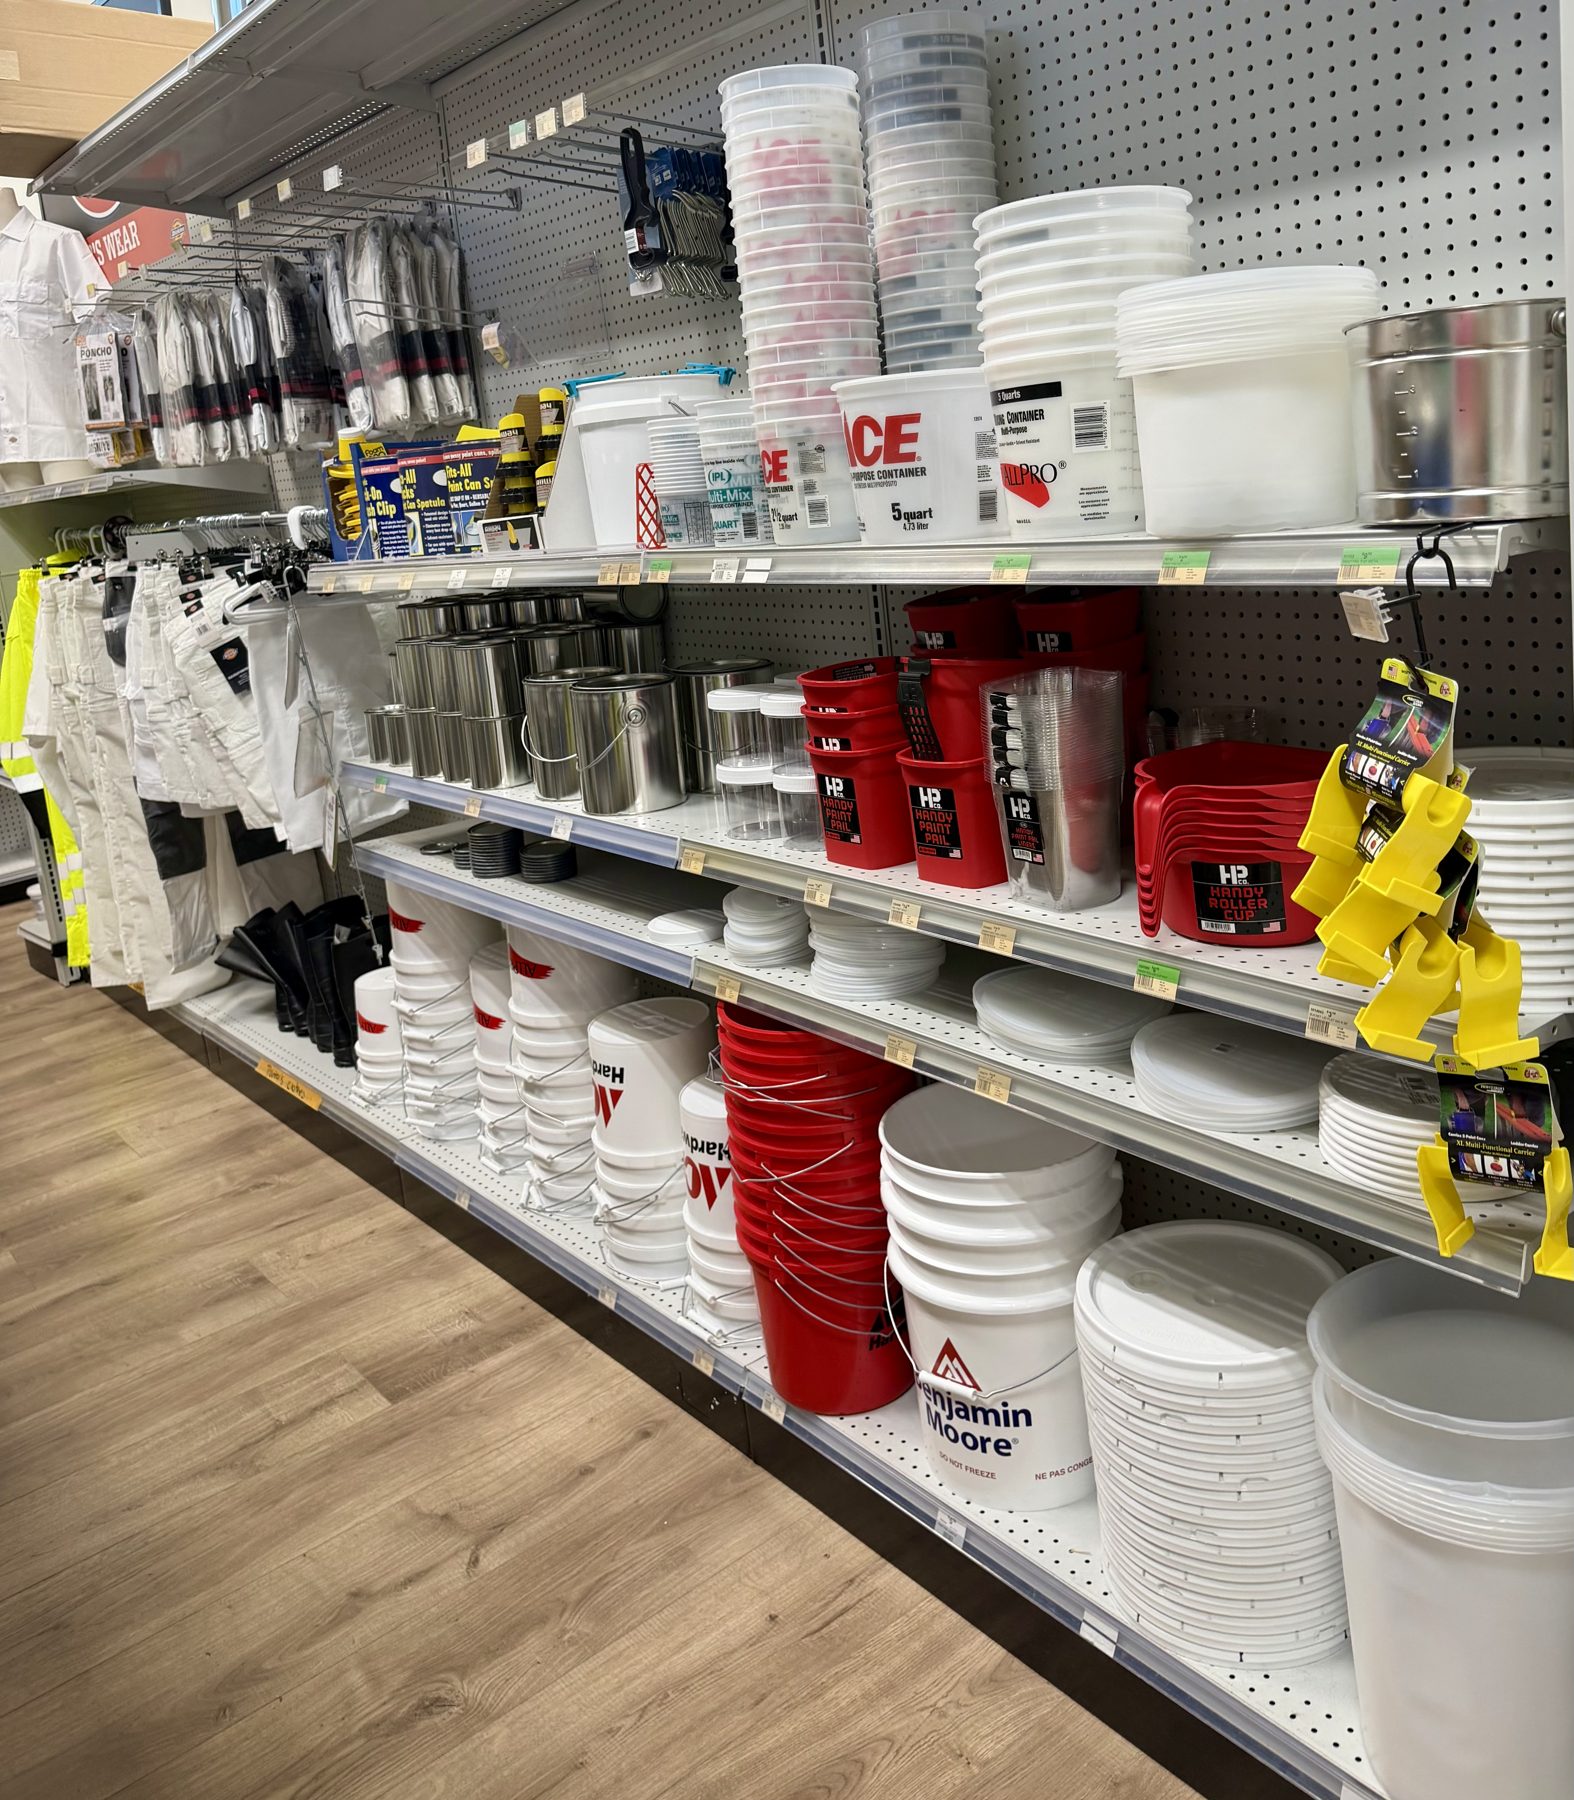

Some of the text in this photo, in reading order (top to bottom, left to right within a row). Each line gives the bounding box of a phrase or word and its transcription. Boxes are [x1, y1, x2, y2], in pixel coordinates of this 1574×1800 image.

[90, 220, 140, 266] 'S WEAR
[80, 346, 112, 358] PONCHO
[1001, 390, 1021, 401] Quarts
[1006, 408, 1045, 425] CONTAINER
[876, 467, 927, 480] CONTAINER
[464, 478, 482, 491] Can
[708, 488, 751, 502] ulti-Mix
[376, 500, 397, 519] Clip
[416, 497, 446, 510] Spatula
[782, 512, 798, 523] quart
[891, 502, 933, 522] 5 quart
[822, 798, 854, 811] HANDY
[825, 809, 852, 822] PAINT
[915, 810, 953, 823] HANDY
[830, 819, 851, 832] PAIL
[918, 821, 951, 835] PAINT
[925, 832, 950, 846] PAIL
[1210, 886, 1264, 898] HANDY
[1208, 897, 1268, 910] ROLLER
[1223, 910, 1255, 921] CUP
[1464, 1141, 1513, 1154] Multi-Functional
[1513, 1148, 1536, 1157] Carrier
[926, 1402, 1012, 1457] Moore
[949, 1457, 963, 1470] NOT
[964, 1464, 997, 1480] FREEZE
[1034, 1472, 1047, 1481] NE
[1049, 1468, 1066, 1478] PAS
